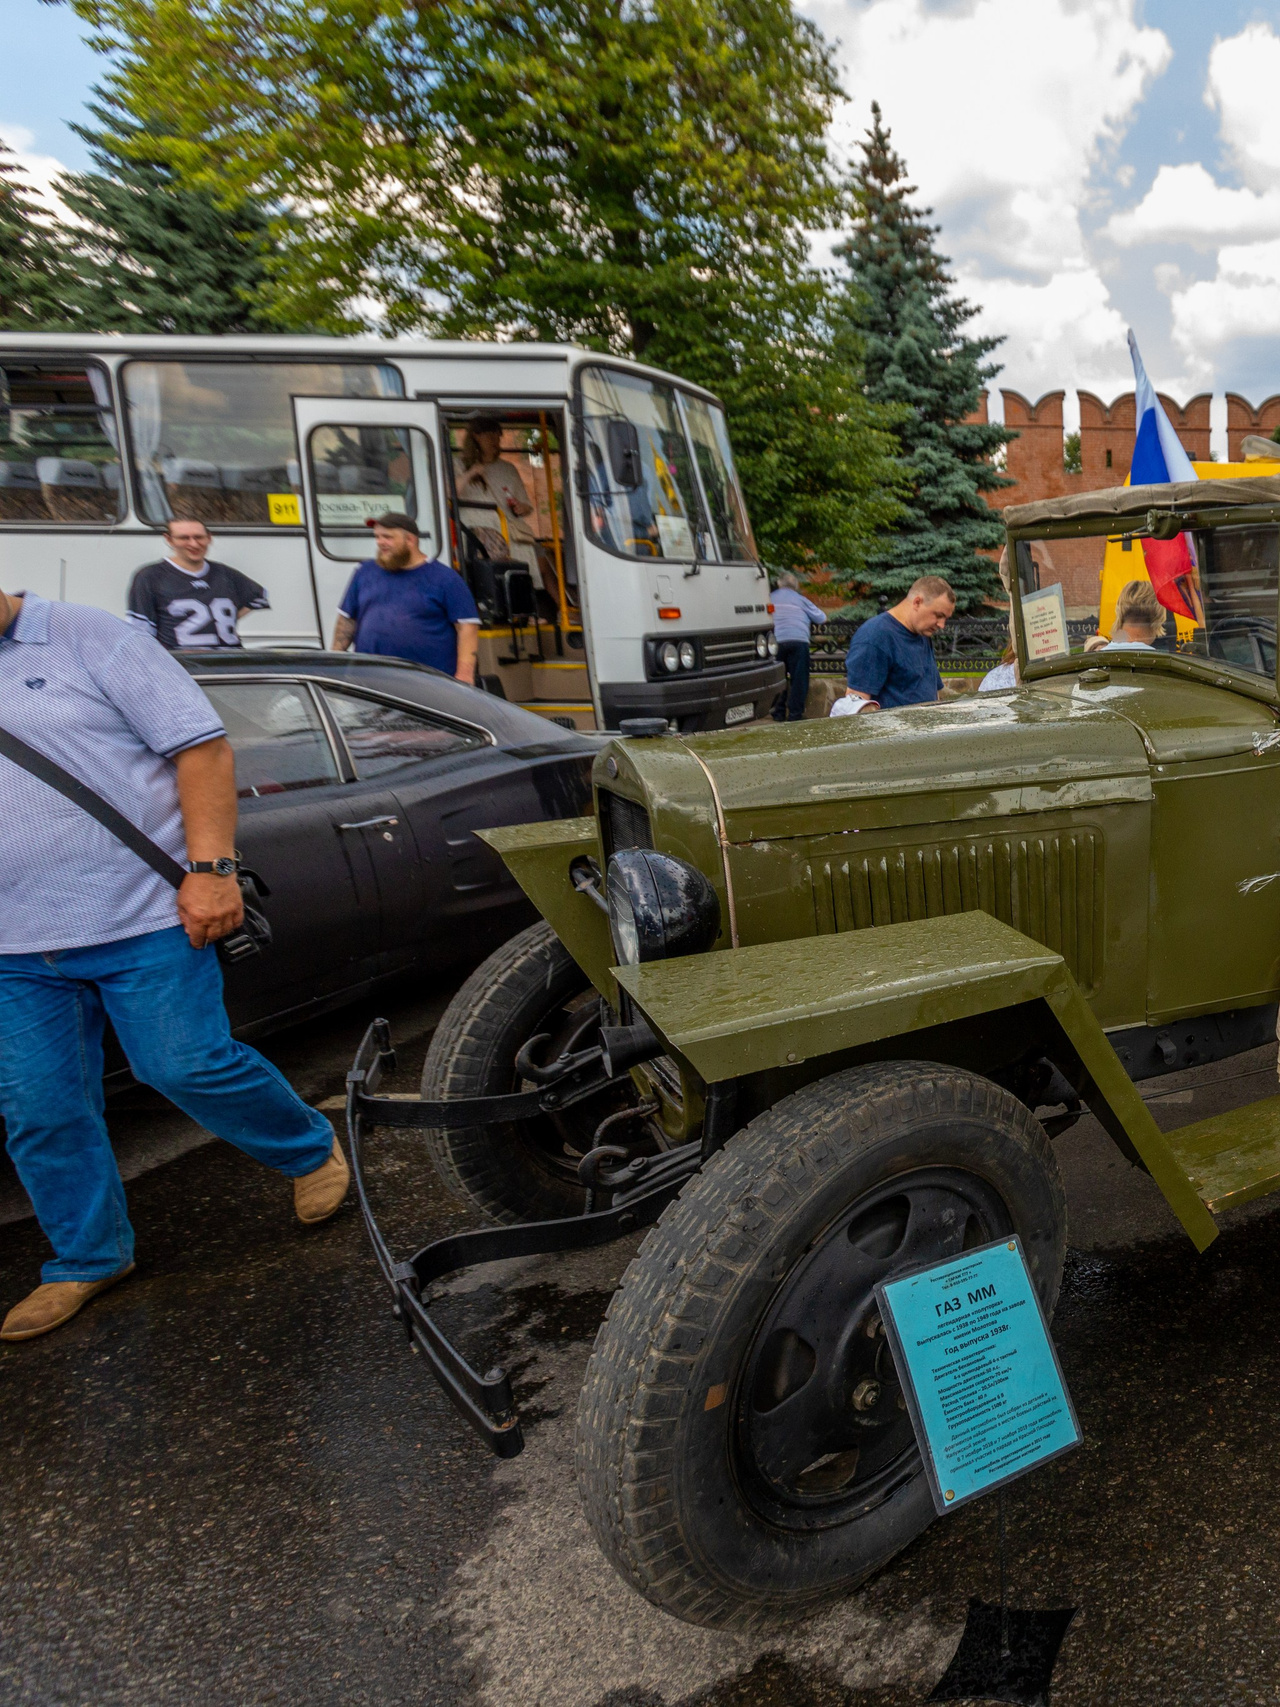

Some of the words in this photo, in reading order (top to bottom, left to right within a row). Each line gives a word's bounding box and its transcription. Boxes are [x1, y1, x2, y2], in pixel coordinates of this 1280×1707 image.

[273, 502, 296, 514] 911
[167, 598, 240, 645] 28
[935, 1297, 961, 1317] ГАЗ
[967, 1284, 996, 1304] ММ
[916, 1330, 952, 1346] Выпускалась
[956, 1322, 968, 1330] 1938
[977, 1314, 989, 1322] 1949
[1009, 1300, 1026, 1309] заводе
[938, 1313, 970, 1329] легендарная
[971, 1300, 1003, 1315] «полуторка»
[945, 1346, 959, 1355] Год
[960, 1333, 989, 1349] выпуска
[990, 1325, 1011, 1336] 1938г.
[954, 1330, 971, 1340] имени
[972, 1320, 997, 1333] Молотова
[931, 1359, 960, 1373] Техническая
[934, 1369, 958, 1381] Двигатель
[958, 1355, 986, 1370] бензиновый
[961, 1360, 992, 1377] цилиндровый
[938, 1382, 962, 1394] Мощность
[940, 1384, 974, 1401] Максимальная
[942, 1399, 959, 1409] Расход
[959, 1390, 977, 1400] топлива
[946, 1397, 996, 1423] Электрооборудование
[952, 1428, 970, 1441] Данный
[971, 1417, 997, 1431] автомобиль
[1007, 1405, 1021, 1414] собран
[1028, 1393, 1044, 1405] деталей
[973, 1424, 997, 1437] найденных
[1002, 1416, 1016, 1424] местах
[1016, 1408, 1031, 1417] боевых
[1033, 1398, 1051, 1411] действий
[991, 1402, 1002, 1410] 1500
[965, 1448, 982, 1458] ноября
[1002, 1430, 1017, 1440] ноября
[1038, 1409, 1062, 1422] автомобиль
[946, 1444, 971, 1459] Калужской
[973, 1437, 986, 1446] земле
[950, 1459, 974, 1473] принимал
[975, 1451, 992, 1462] участие
[996, 1441, 1012, 1451] параде
[1019, 1428, 1036, 1440] Красной
[974, 1459, 1000, 1474] Автомобиль
